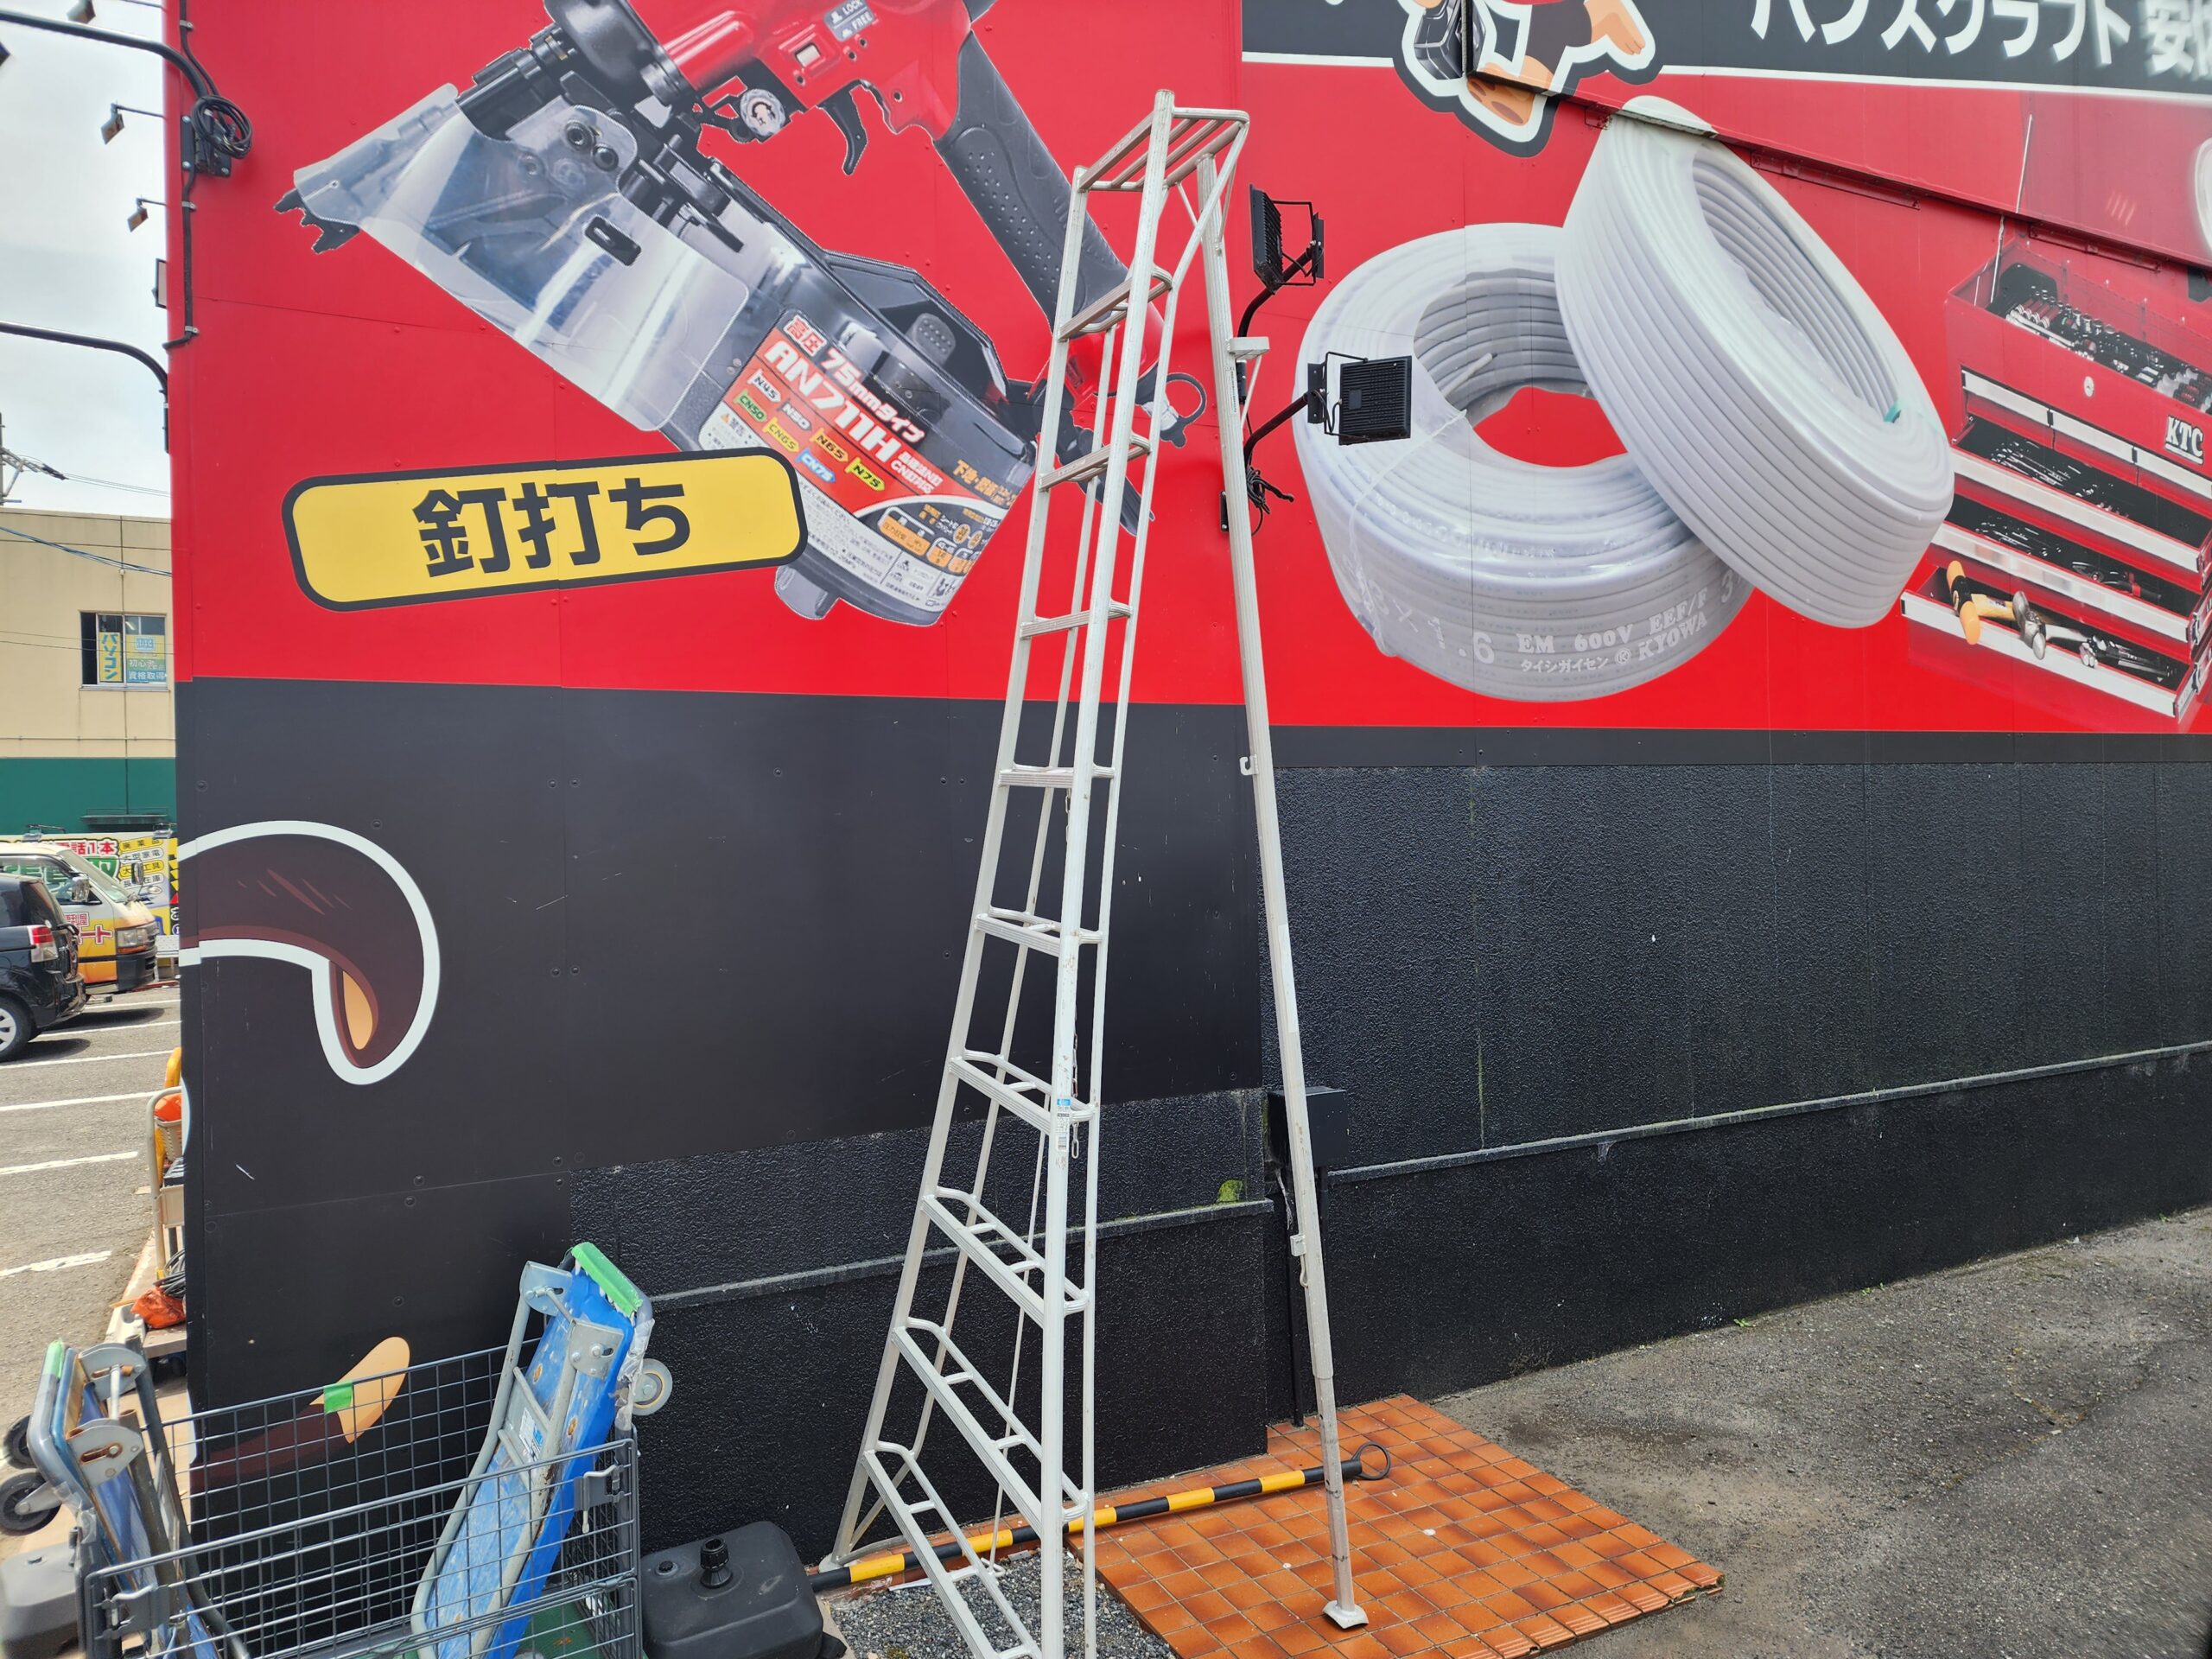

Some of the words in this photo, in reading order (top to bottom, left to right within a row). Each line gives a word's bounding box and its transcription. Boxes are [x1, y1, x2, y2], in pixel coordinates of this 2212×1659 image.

[754, 376, 779, 401] N45
[785, 317, 823, 355] 高圧
[821, 347, 925, 443] 75mmタイプ
[739, 395, 765, 420] CN50
[765, 340, 901, 463] AN711H
[783, 404, 811, 430] N50
[769, 424, 796, 449] CN65
[817, 435, 845, 460] N65
[2165, 416, 2203, 458] KTC
[800, 454, 833, 481] CN75
[854, 464, 881, 487] N75
[412, 477, 690, 578] 釘打ち
[1516, 633, 1555, 653] EM
[1574, 624, 1633, 652] 600V
[1649, 587, 1707, 635] EEF/F
[1521, 657, 1608, 673] タイシガイセン
[1638, 611, 1707, 661] KYOWA
[103, 634, 118, 679] パソコン
[55, 841, 116, 855] 話1本
